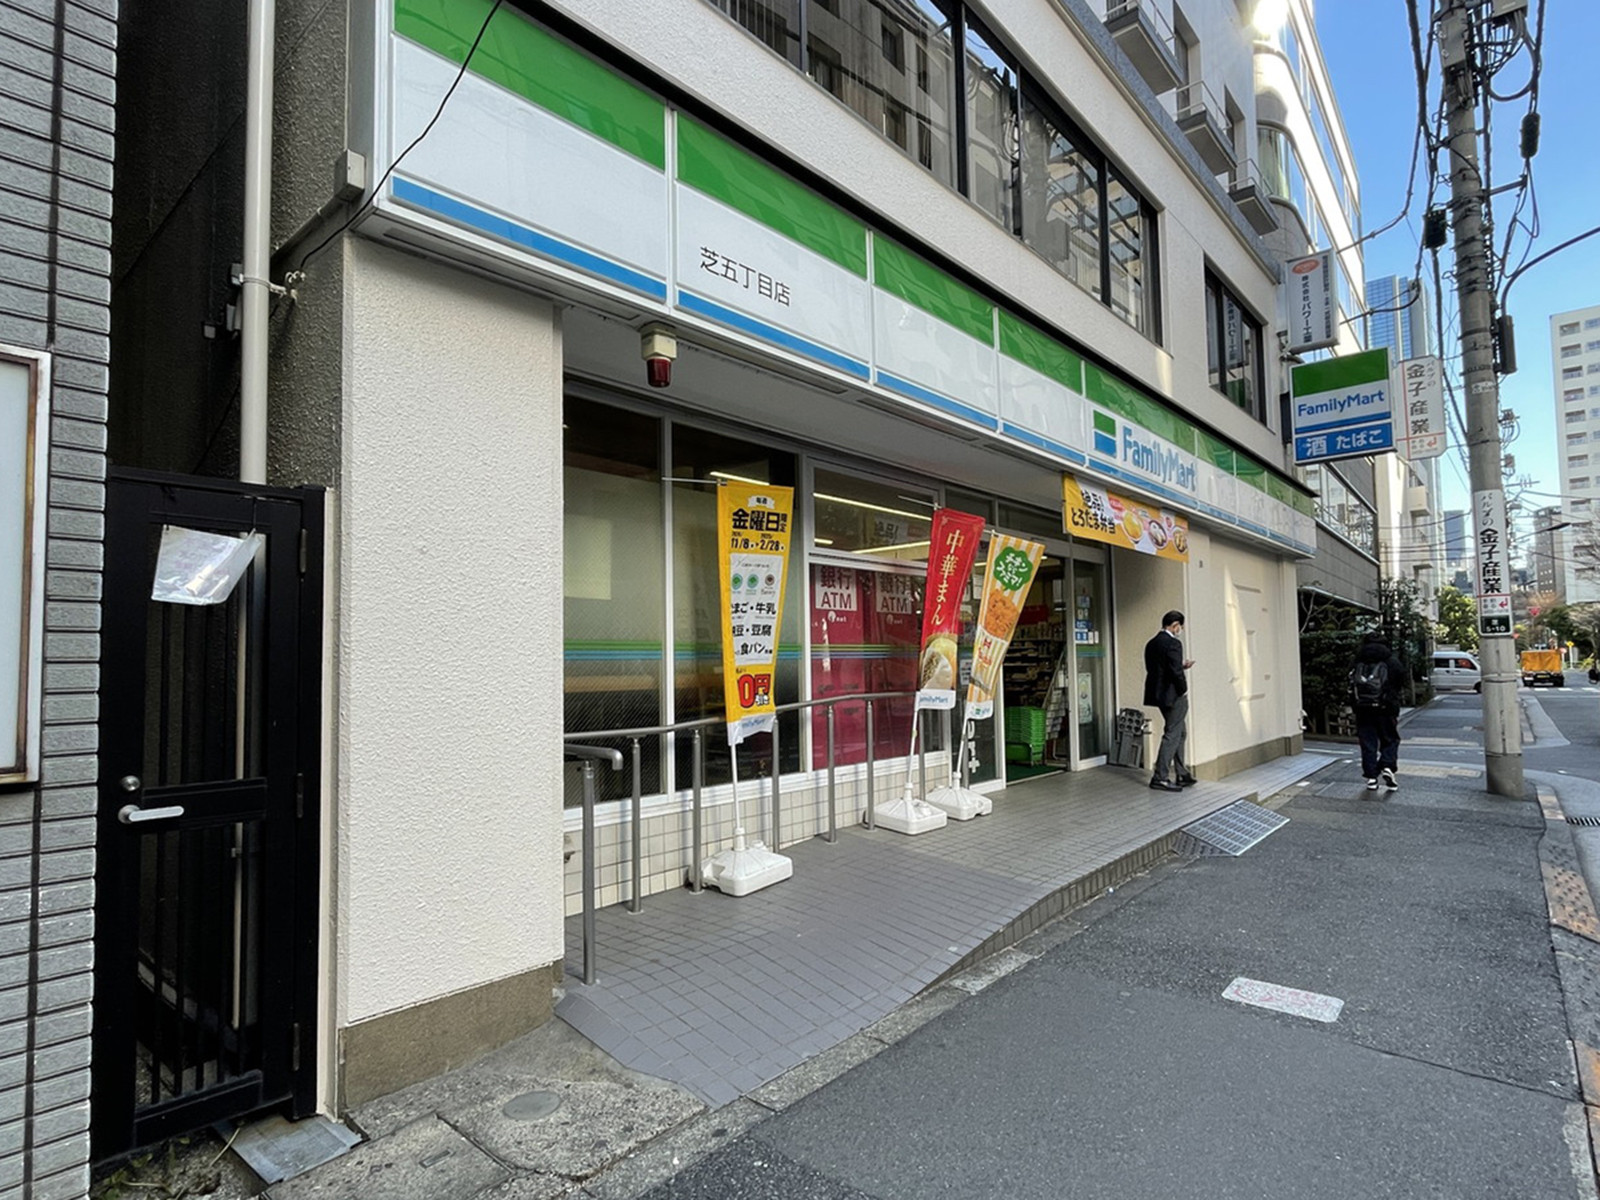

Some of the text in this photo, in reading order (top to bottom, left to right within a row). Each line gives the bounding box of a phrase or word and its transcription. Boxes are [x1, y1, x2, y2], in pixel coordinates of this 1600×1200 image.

[699, 246, 791, 308] 芝五丁目店
[1297, 389, 1385, 418] FamilyMart
[1406, 363, 1430, 436] 金子産業
[1305, 429, 1384, 457] 酒 たばこ
[1122, 425, 1197, 492] FamilyMart
[731, 508, 780, 532] 金曜日
[1071, 507, 1116, 534] とろたま弁当
[821, 566, 852, 590] 銀行
[930, 529, 965, 626] 中華まん
[821, 591, 852, 609] ATM
[880, 596, 908, 613] ATM
